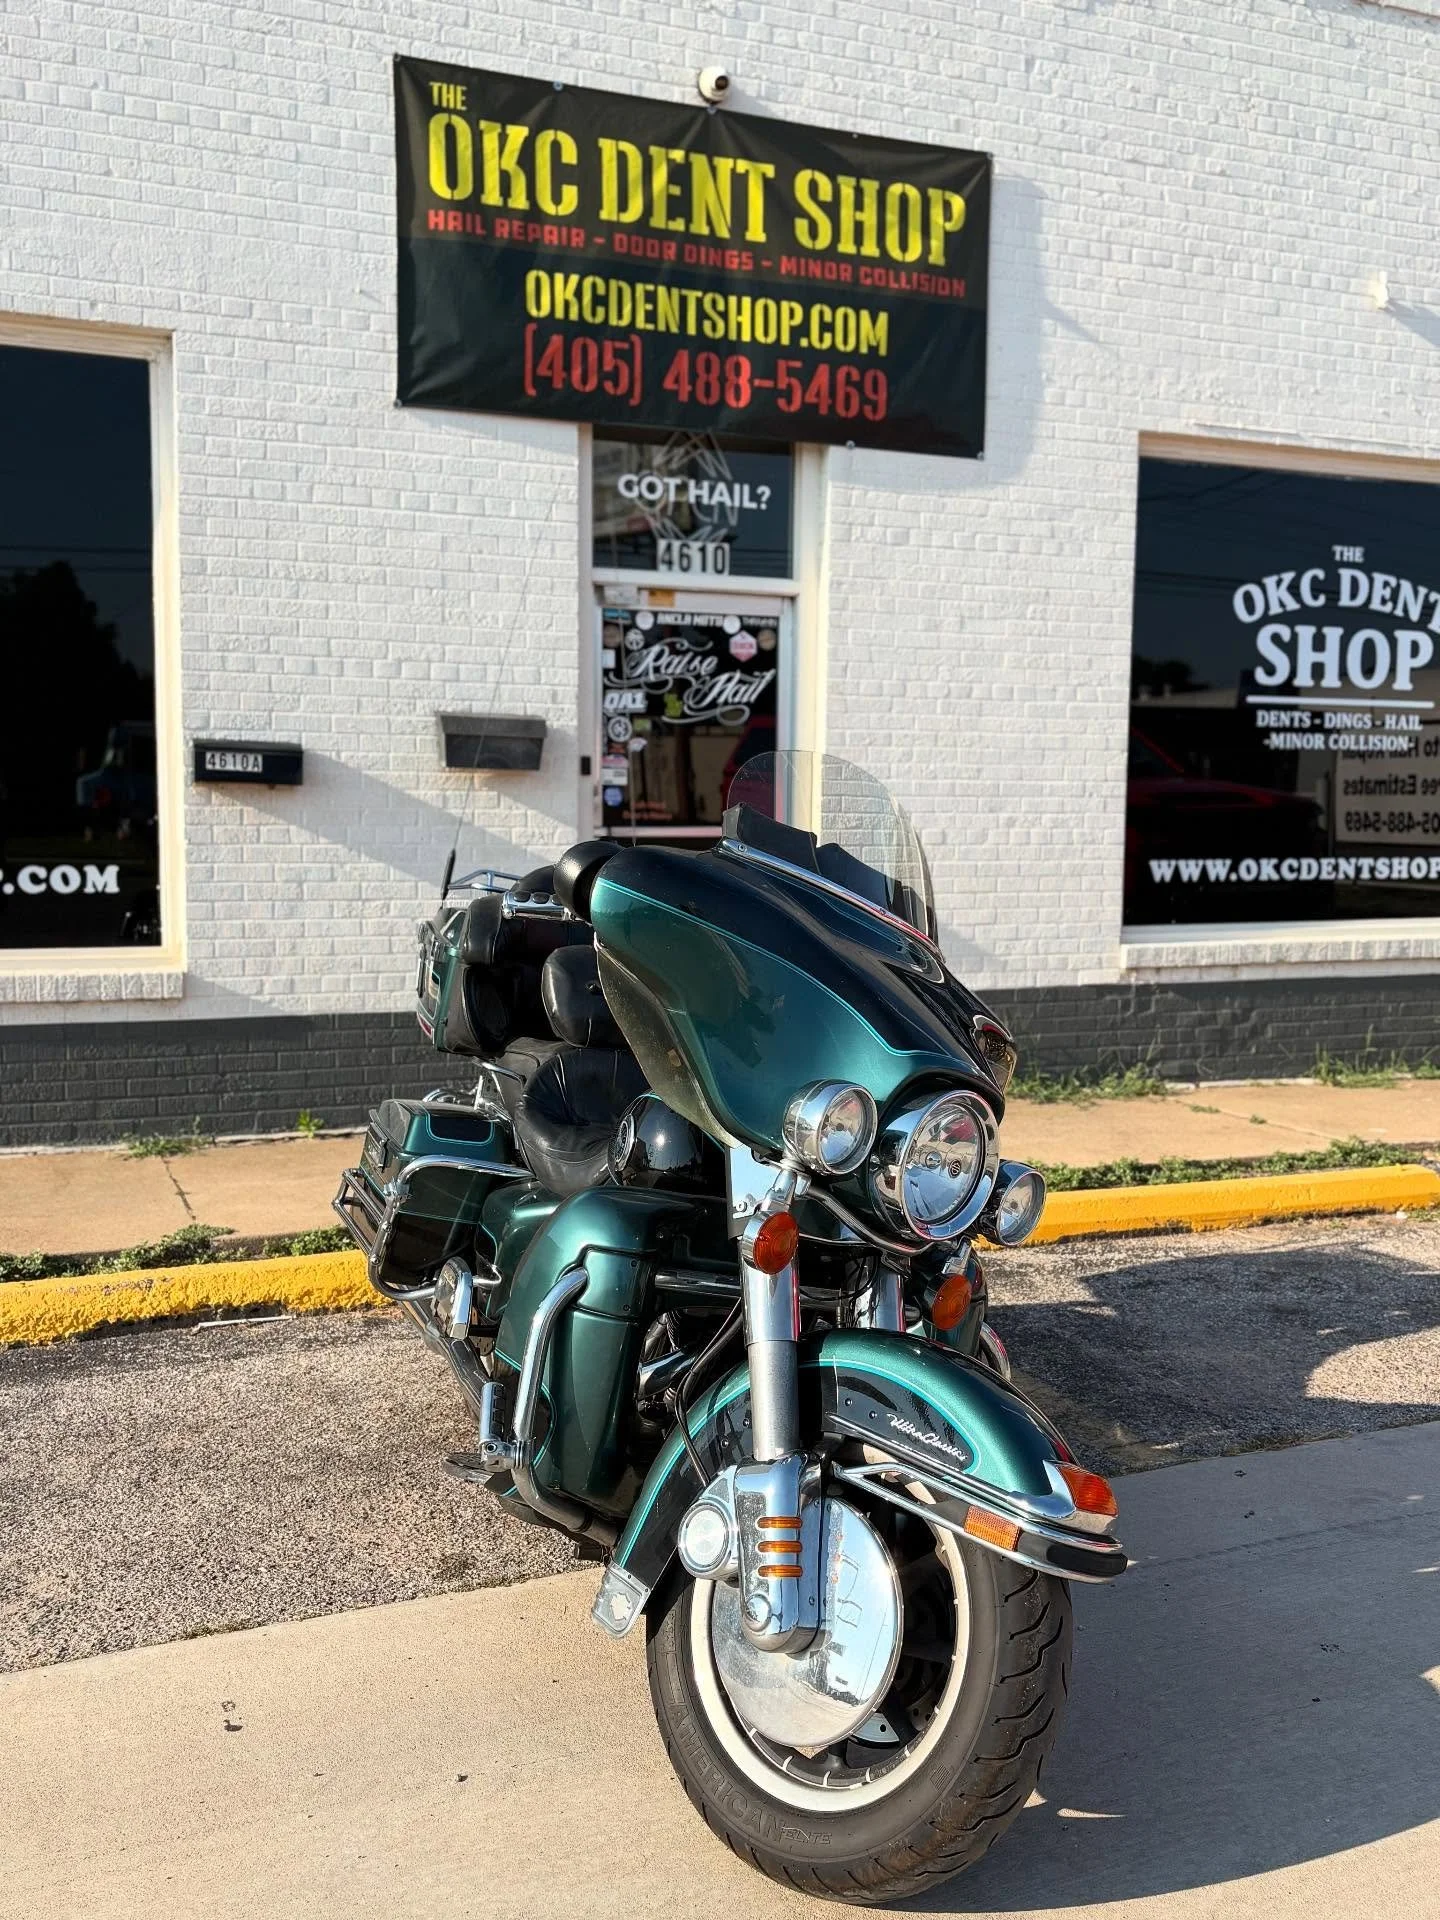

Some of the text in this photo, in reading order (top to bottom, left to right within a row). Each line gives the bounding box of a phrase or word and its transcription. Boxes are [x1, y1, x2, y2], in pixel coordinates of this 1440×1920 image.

[431, 82, 467, 111] THE
[428, 113, 967, 266] OKC DENT SHOP
[426, 208, 487, 236] HAIL
[493, 216, 586, 248] REPAIR
[612, 232, 677, 261] DOOR
[684, 240, 754, 271] DINGS
[779, 256, 853, 283] MINOR
[858, 266, 966, 298] COLLISION
[525, 269, 889, 356] OKCDENTSHOP.COM
[523, 322, 888, 422] (405) 488-5469
[617, 473, 681, 502] GOT
[688, 479, 772, 511] HAIL?
[660, 541, 727, 574] 4610
[1331, 544, 1365, 564] THE
[1232, 568, 1326, 624] OKC
[622, 639, 718, 683] Raise
[1254, 623, 1435, 692] SHOP
[684, 668, 777, 711] Hail
[1256, 709, 1311, 729] DENTS
[1323, 711, 1373, 730] DINGS
[1383, 713, 1424, 732] HAIL
[206, 752, 261, 770] 4610A
[0, 864, 121, 894] .COM
[1148, 855, 1440, 883] WWW.OKCDENTSHOP
[670, 1706, 785, 1844] AMERICAN
